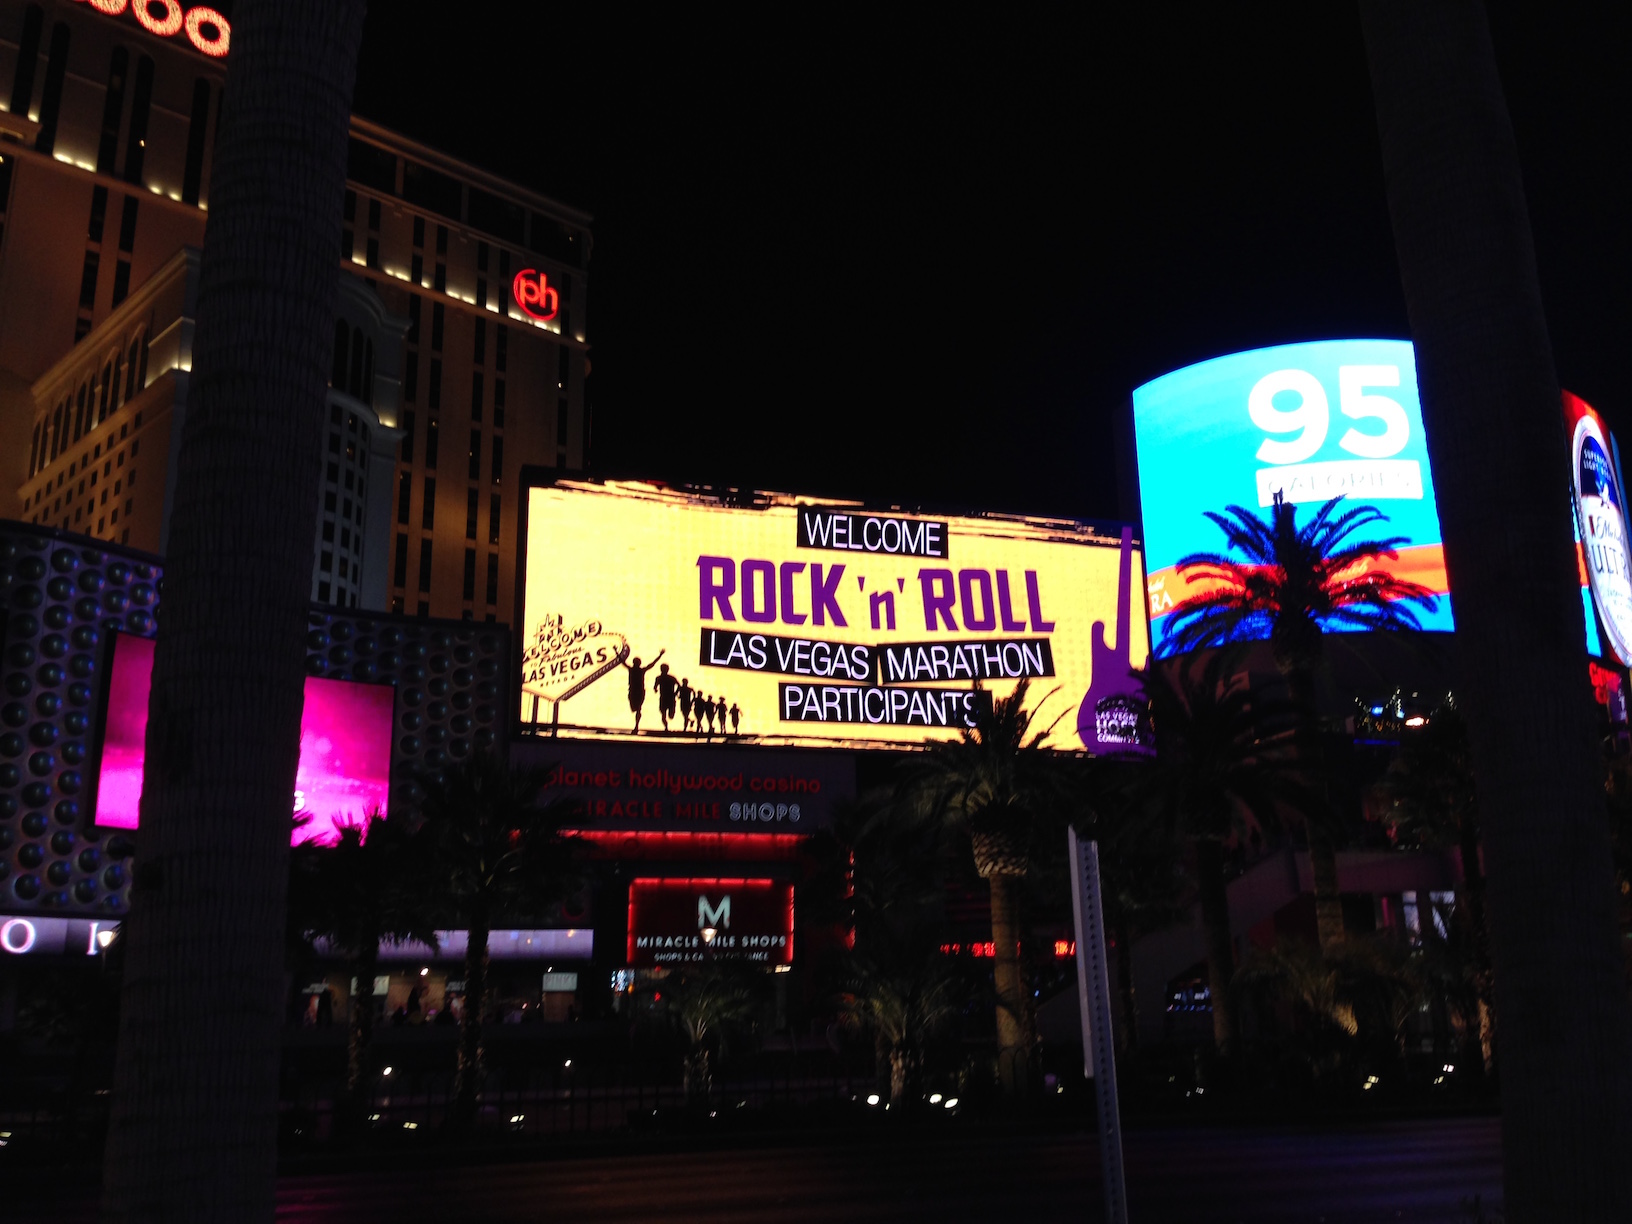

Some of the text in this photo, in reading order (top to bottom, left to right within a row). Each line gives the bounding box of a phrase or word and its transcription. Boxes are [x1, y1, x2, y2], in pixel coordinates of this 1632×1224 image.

[519, 272, 558, 312] ph
[1248, 365, 1410, 464] 95
[804, 513, 942, 556] WELCOME
[696, 556, 848, 627] ROCK
[917, 568, 1055, 633] ROLL
[550, 647, 607, 677] VEGAS
[709, 631, 1045, 682] LAS VEGAS MARATHON
[629, 768, 743, 795] hollywood
[750, 774, 821, 793] casino
[676, 802, 721, 819] MILE
[729, 802, 801, 823] SHOPS
[698, 895, 731, 930] M
[636, 936, 699, 948] MIRACLE
[742, 935, 786, 948] SHOPS
[654, 952, 682, 961] SHOPS
